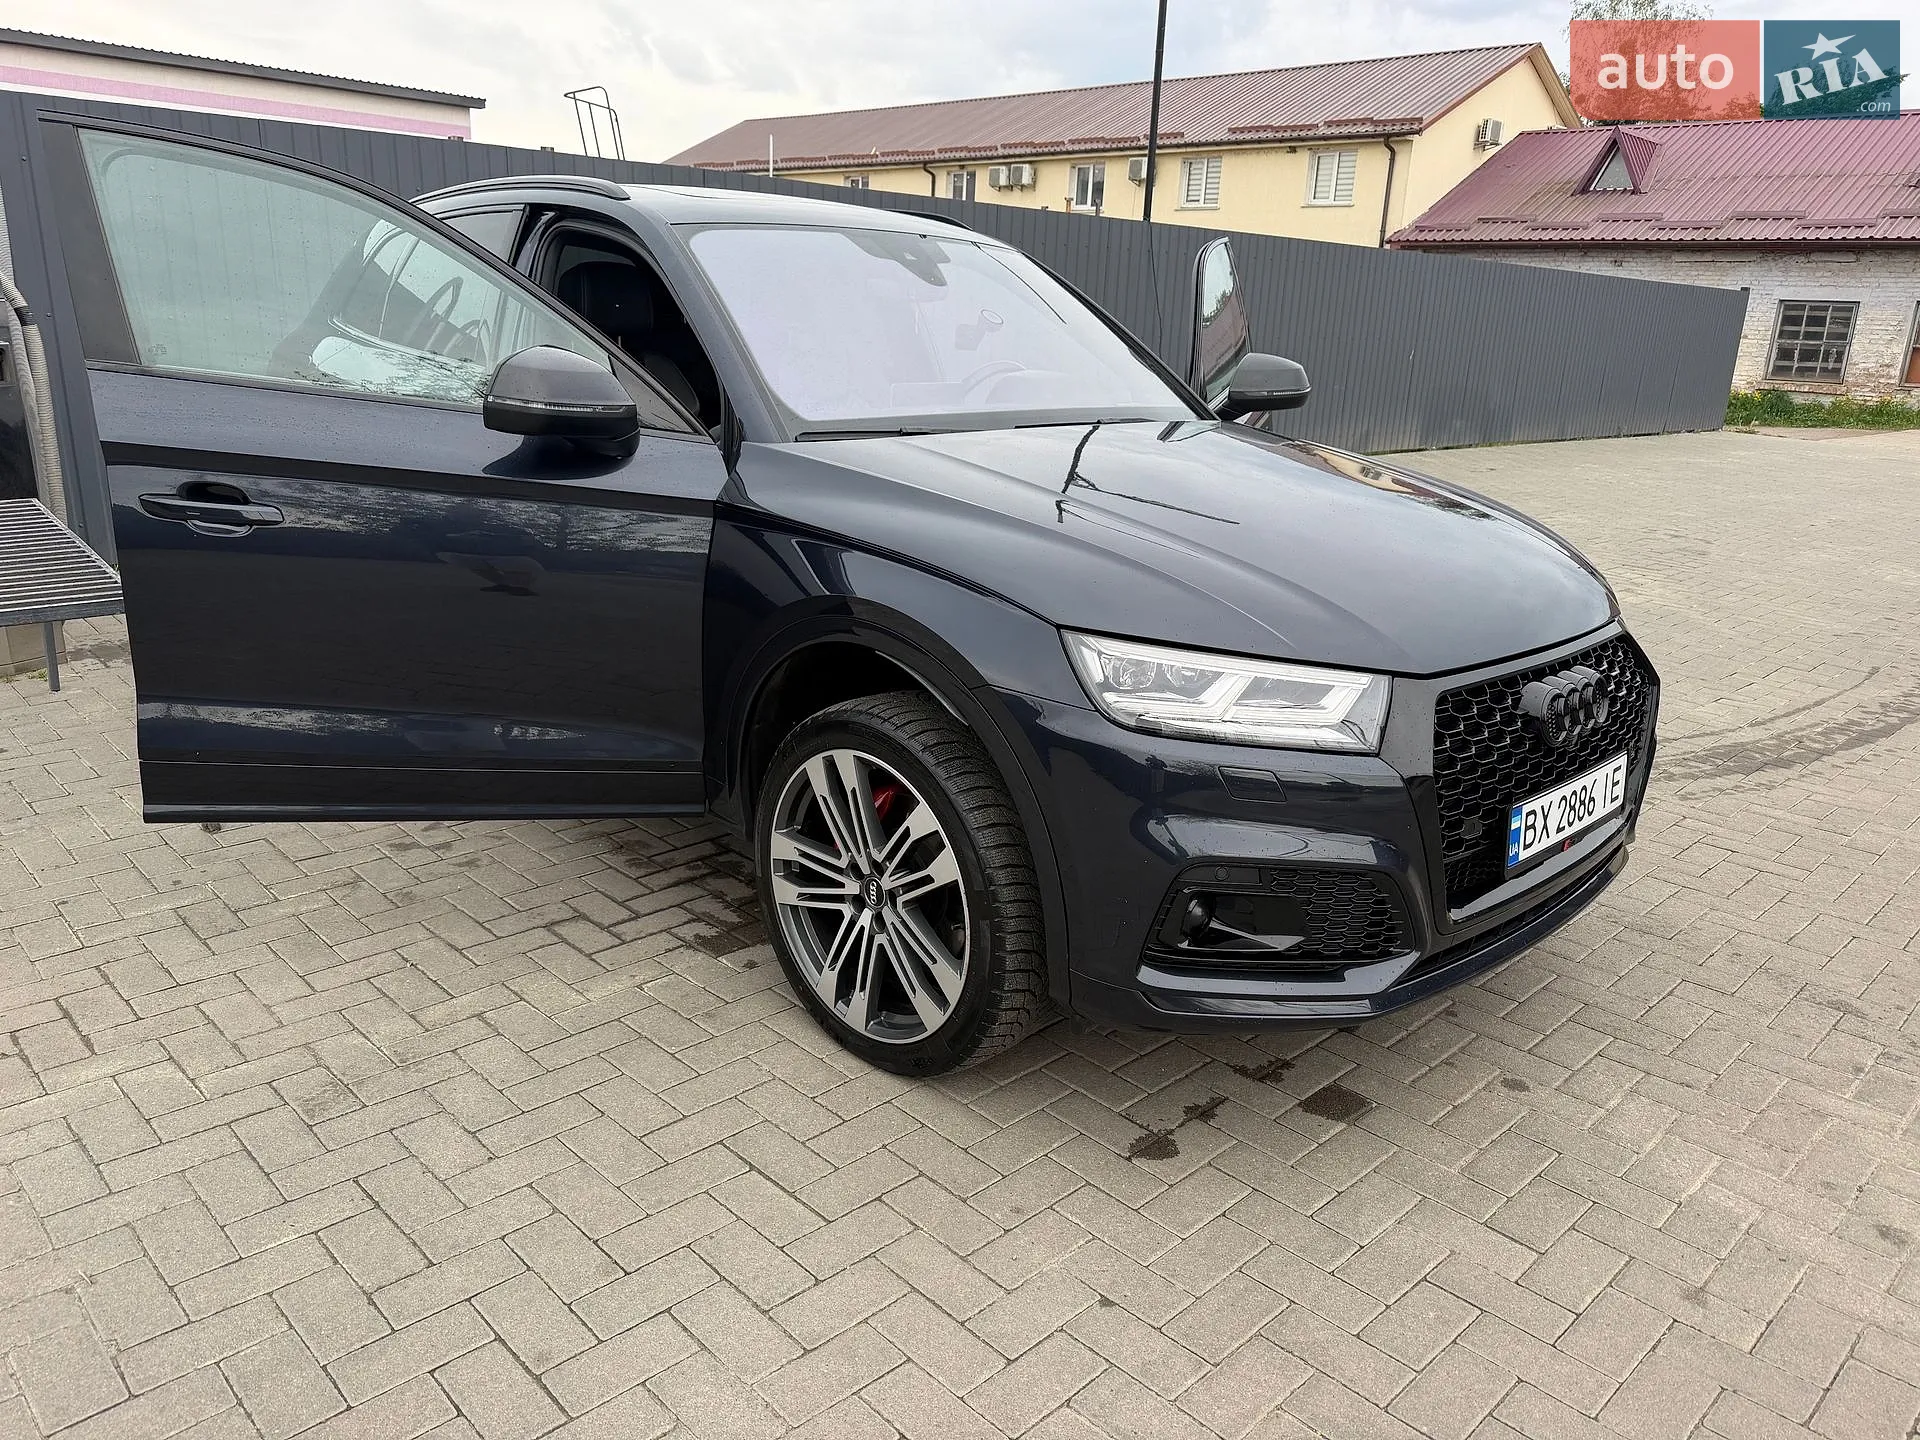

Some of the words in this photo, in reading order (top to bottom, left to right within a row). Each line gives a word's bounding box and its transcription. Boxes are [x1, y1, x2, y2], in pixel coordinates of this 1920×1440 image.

[1523, 801, 1553, 851] BX
[1556, 779, 1597, 835] 2886
[1603, 765, 1622, 808] IE
[1509, 844, 1519, 857] UA
